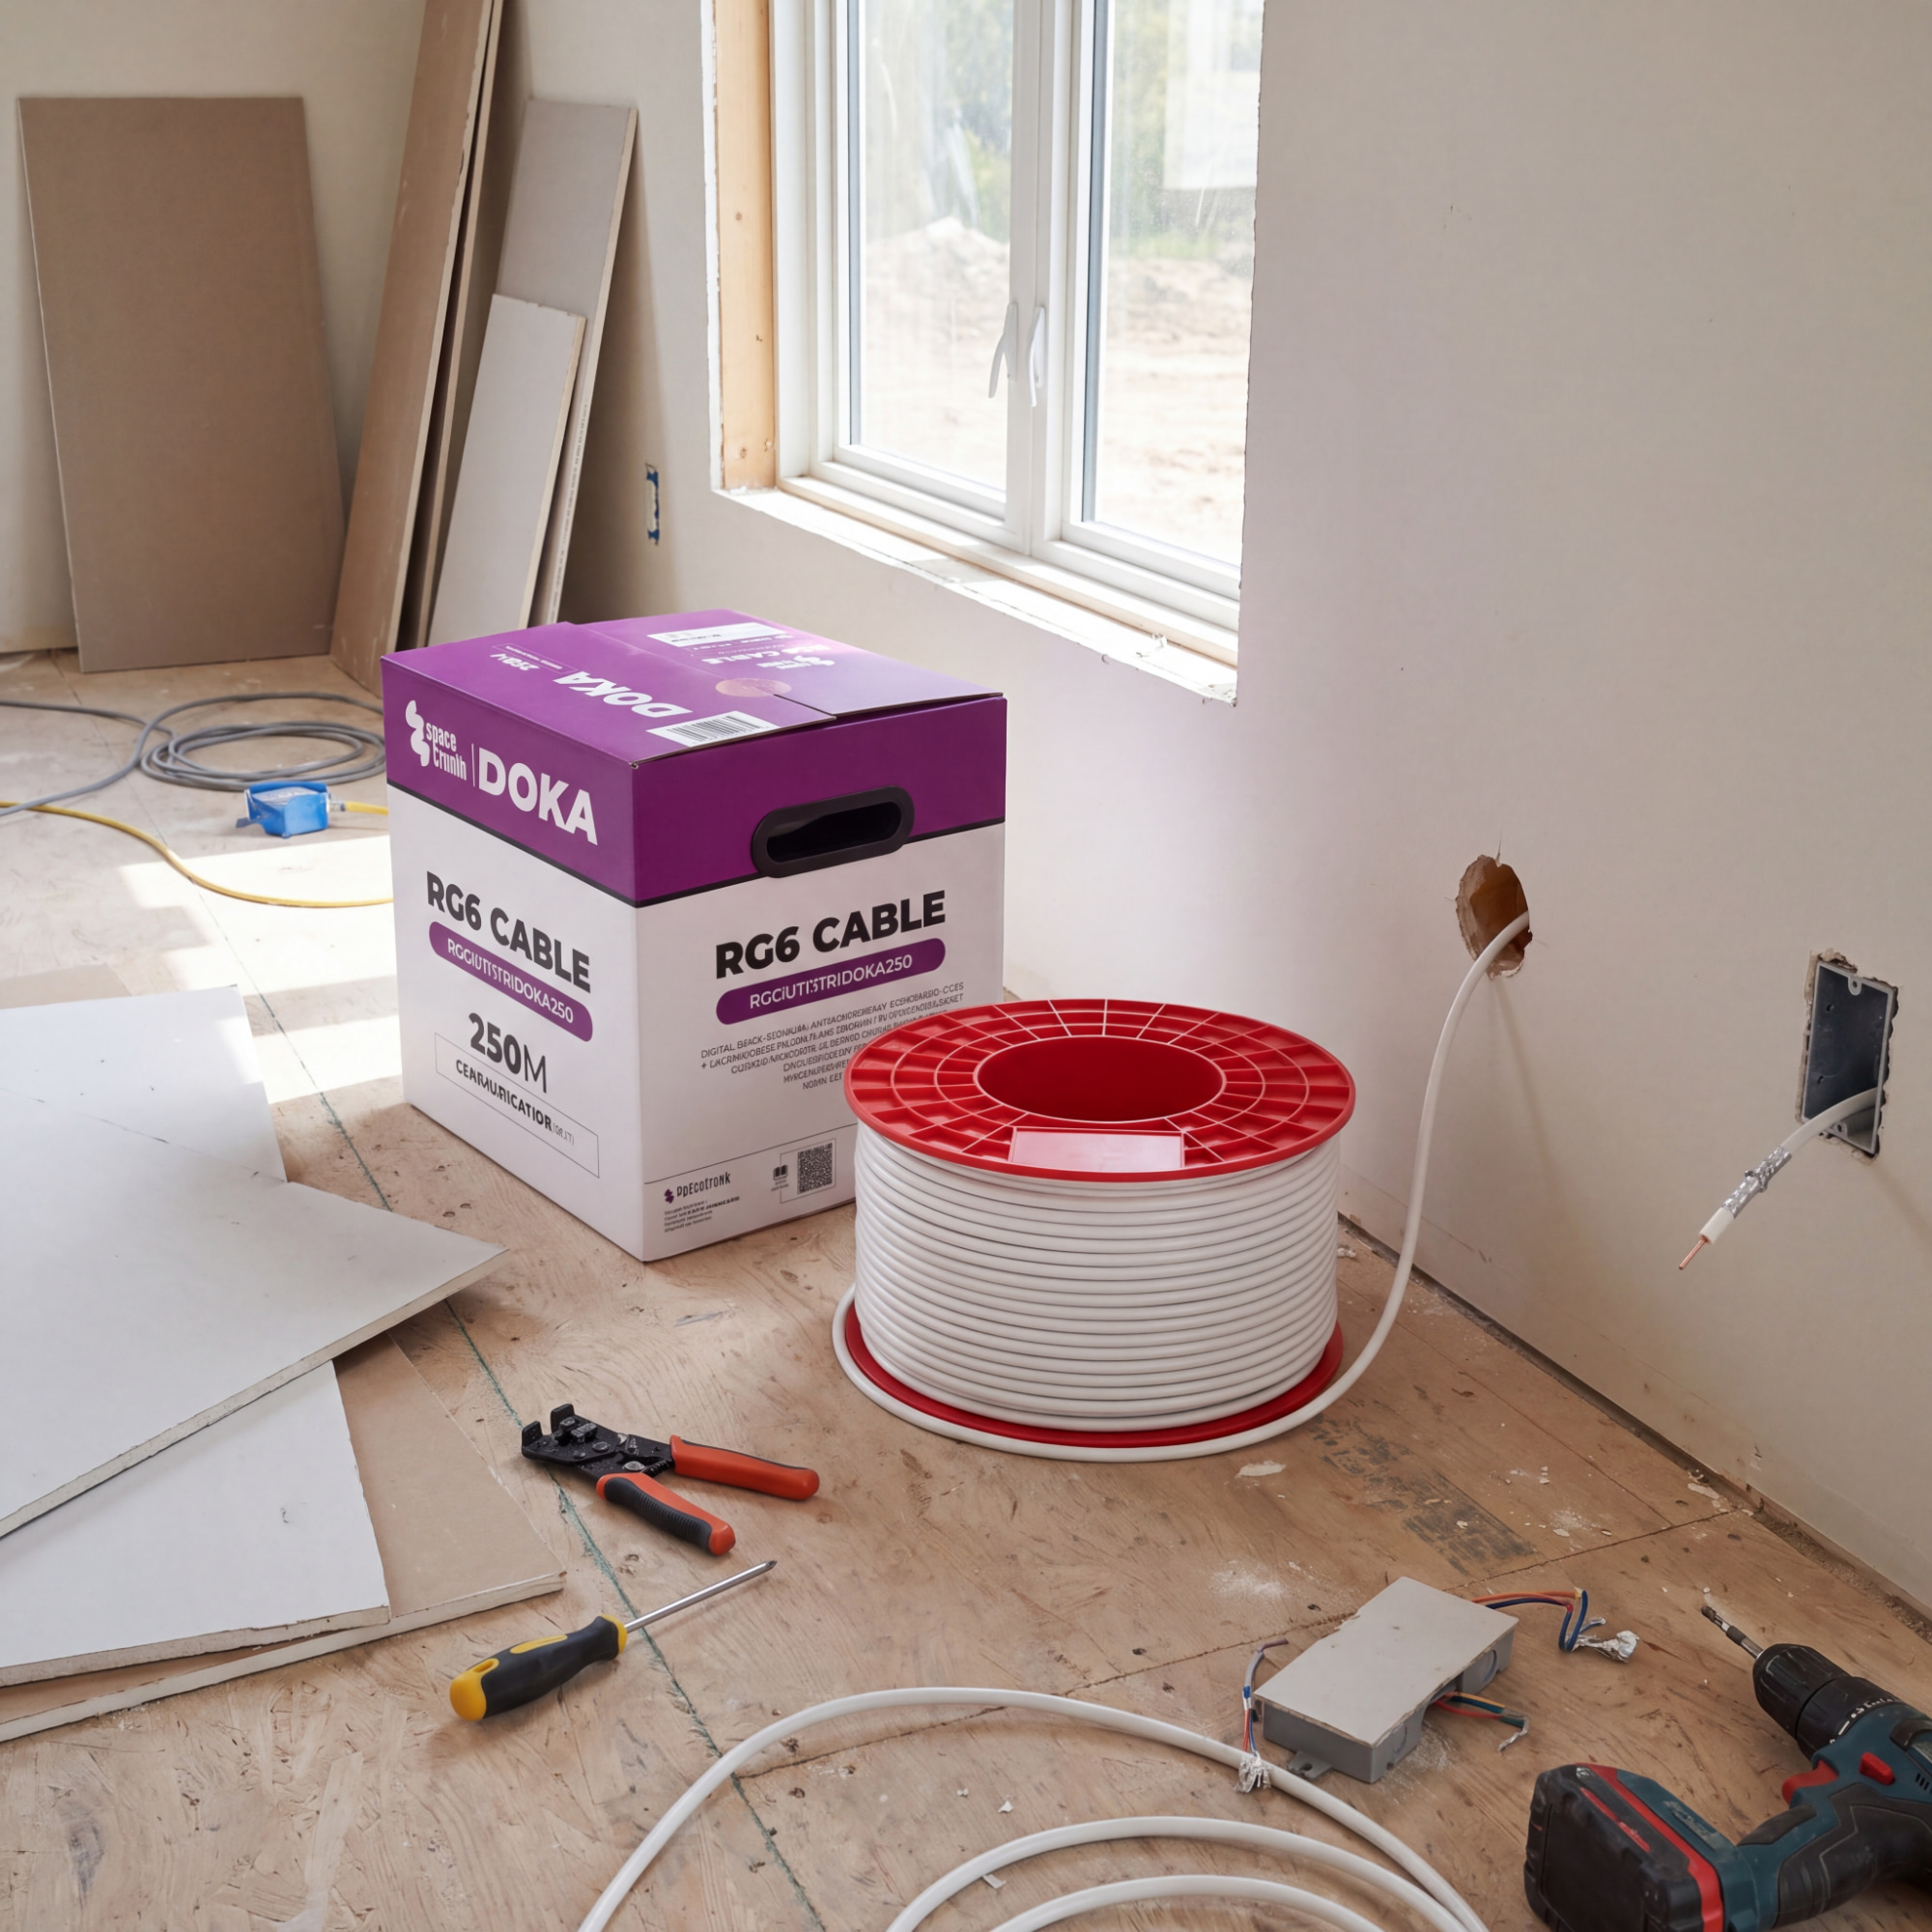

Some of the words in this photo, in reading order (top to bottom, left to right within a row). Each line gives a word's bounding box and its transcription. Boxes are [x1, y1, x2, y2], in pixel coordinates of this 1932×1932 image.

[553, 670, 694, 718] DOKA
[426, 722, 457, 753] space
[478, 747, 598, 846] DOKA
[427, 870, 482, 931] RG6
[490, 907, 591, 994] CABLE
[716, 925, 801, 980] RG6
[812, 890, 946, 953] CABLE
[469, 1012, 547, 1094] 250M
[700, 1043, 735, 1059] DIGITAL
